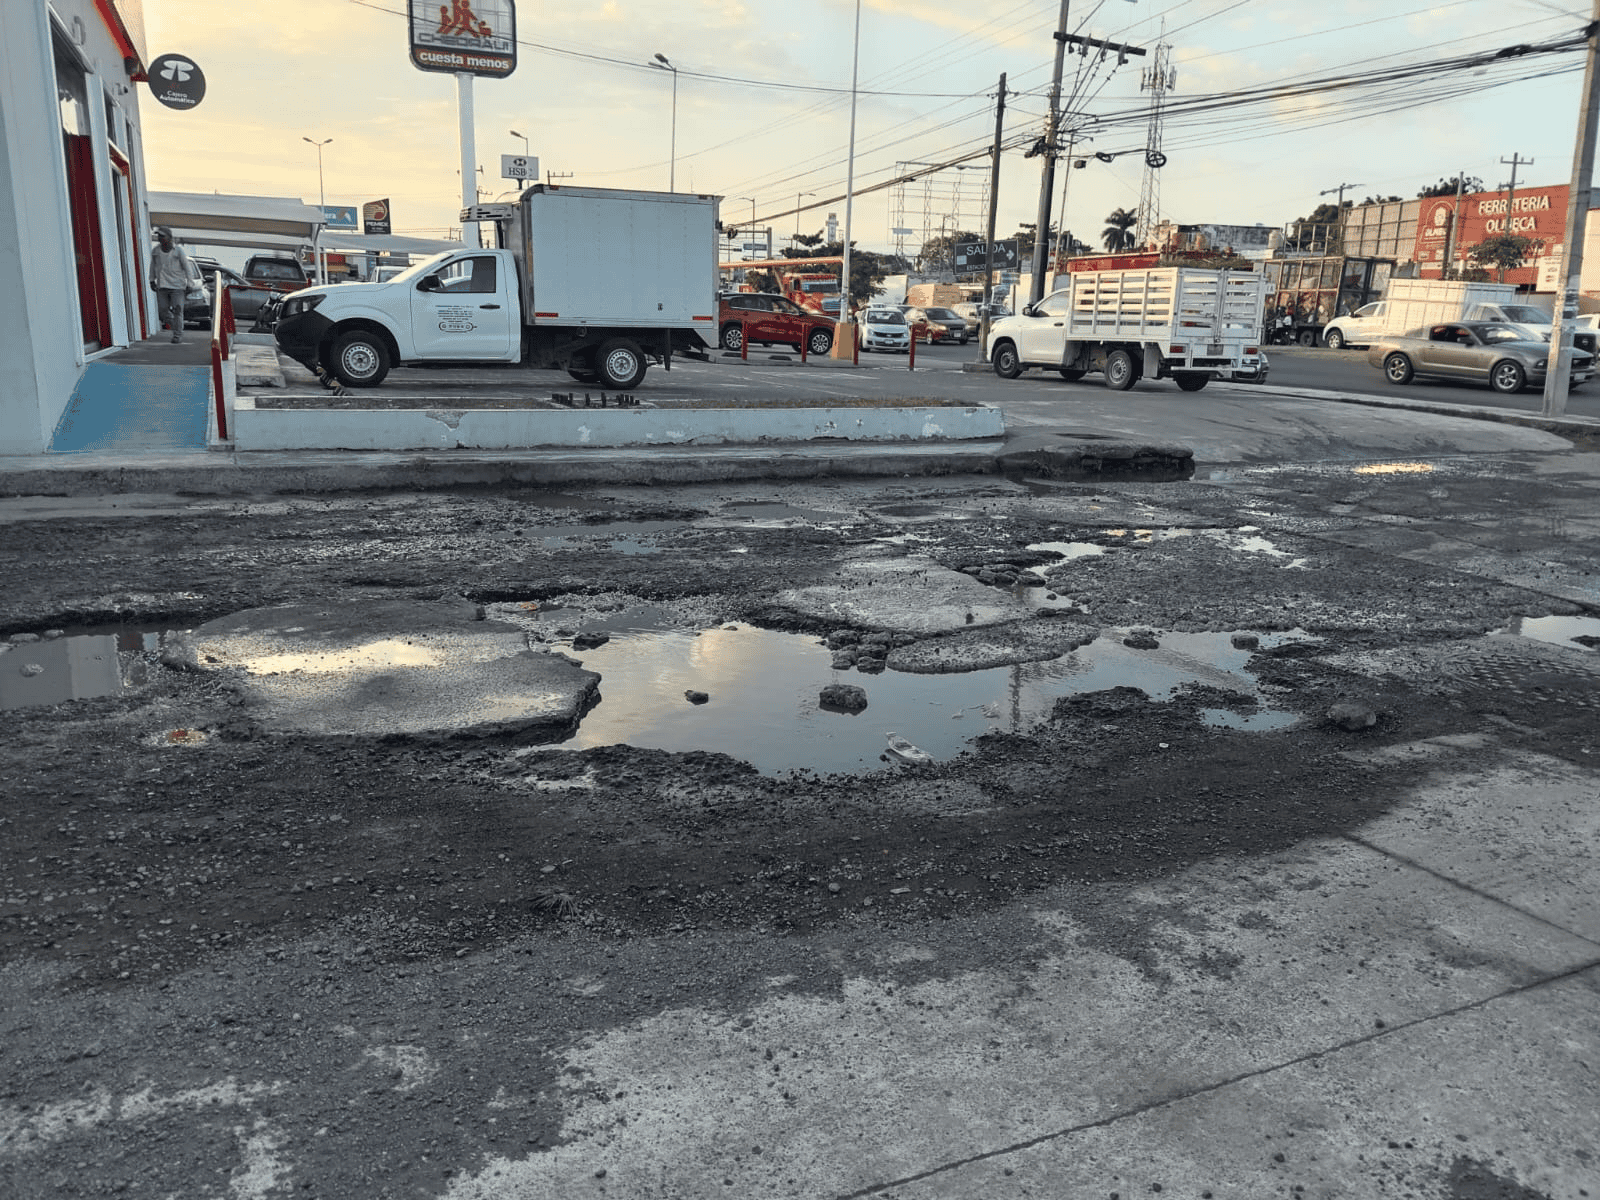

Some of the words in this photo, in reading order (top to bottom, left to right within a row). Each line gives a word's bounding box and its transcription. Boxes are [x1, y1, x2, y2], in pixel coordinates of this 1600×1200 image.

[418, 33, 509, 51] CHEDRAUI
[419, 52, 464, 65] cuesta
[466, 56, 510, 69] menos
[167, 90, 188, 98] Cajero
[966, 243, 1006, 256] SALDA
